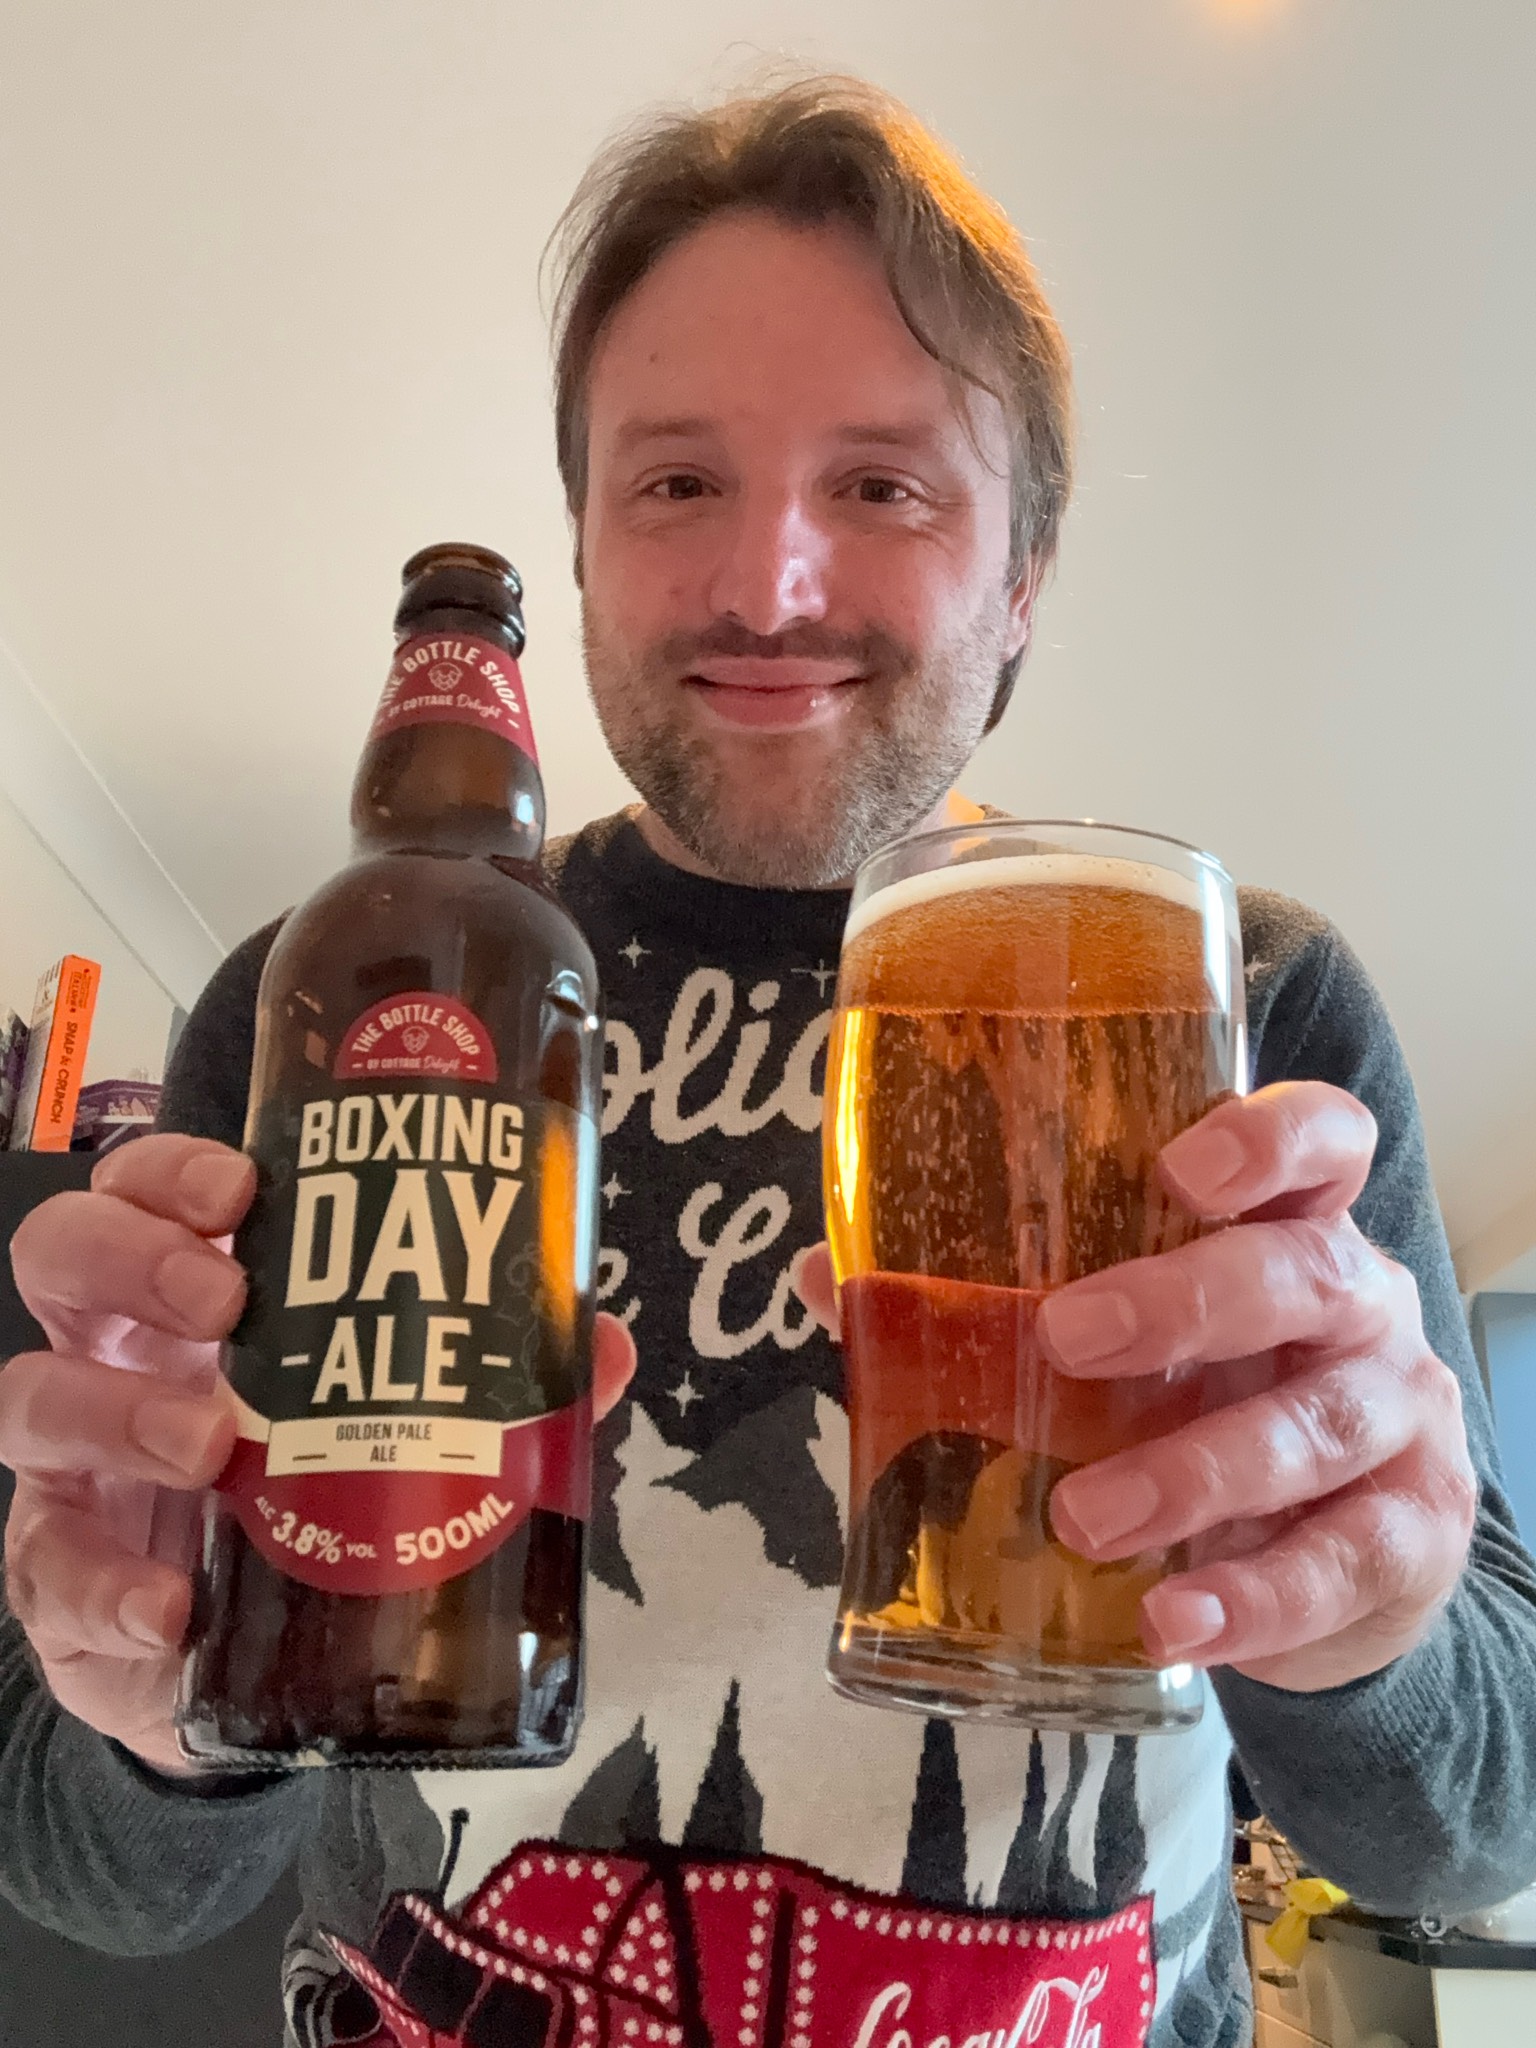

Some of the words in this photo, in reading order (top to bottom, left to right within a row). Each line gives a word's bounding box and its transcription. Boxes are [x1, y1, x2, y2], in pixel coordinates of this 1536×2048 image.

[402, 640, 481, 673] BOTTLE
[479, 660, 521, 714] SHOP
[402, 695, 453, 711] COTTAGE
[456, 693, 503, 719] Delight
[63, 1021, 79, 1055] SNAP
[352, 1022, 384, 1053] THE
[378, 1004, 444, 1031] BOTTLE
[441, 1015, 481, 1056] SHOP
[59, 1055, 71, 1066] &
[366, 1059, 380, 1070] BY
[381, 1057, 421, 1069] COTTAGE
[423, 1055, 460, 1074] Delight
[50, 1068, 70, 1124] CRUNCH
[297, 1094, 525, 1171] BOXING
[283, 1168, 524, 1308] DAY
[310, 1314, 472, 1405] ALE
[336, 1422, 392, 1441] GOLDEN
[397, 1422, 432, 1441] PALE
[370, 1445, 397, 1463] ALE
[254, 1496, 277, 1521] ALC
[272, 1510, 344, 1564] 3.8%
[346, 1542, 377, 1559] VOL
[395, 1492, 515, 1566] 500ML
